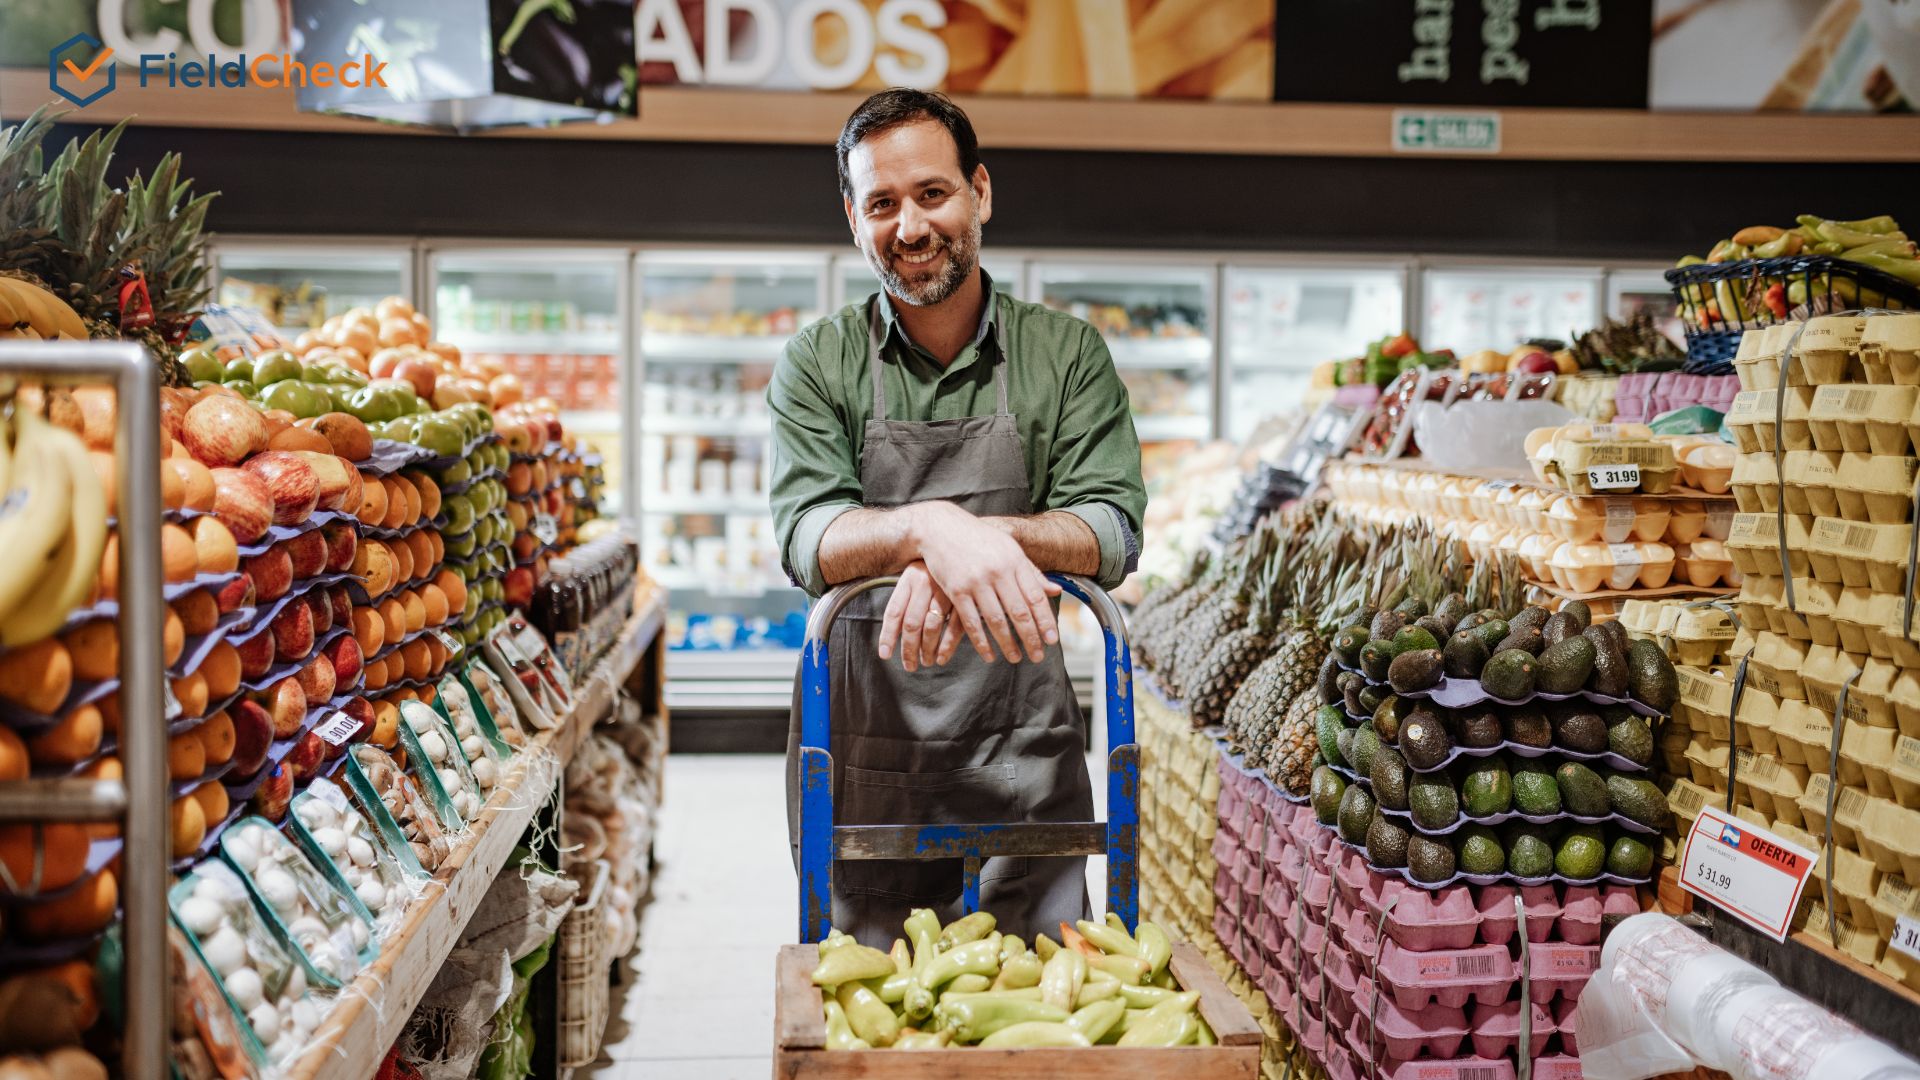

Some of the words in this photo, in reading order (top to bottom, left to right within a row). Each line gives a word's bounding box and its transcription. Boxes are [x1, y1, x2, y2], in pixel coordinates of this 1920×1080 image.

[1590, 472, 1599, 484] $
[1606, 471, 1638, 483] 31.99
[1750, 837, 1798, 869] OFERTA
[1697, 863, 1705, 878] $
[1705, 868, 1731, 890] 31,99
